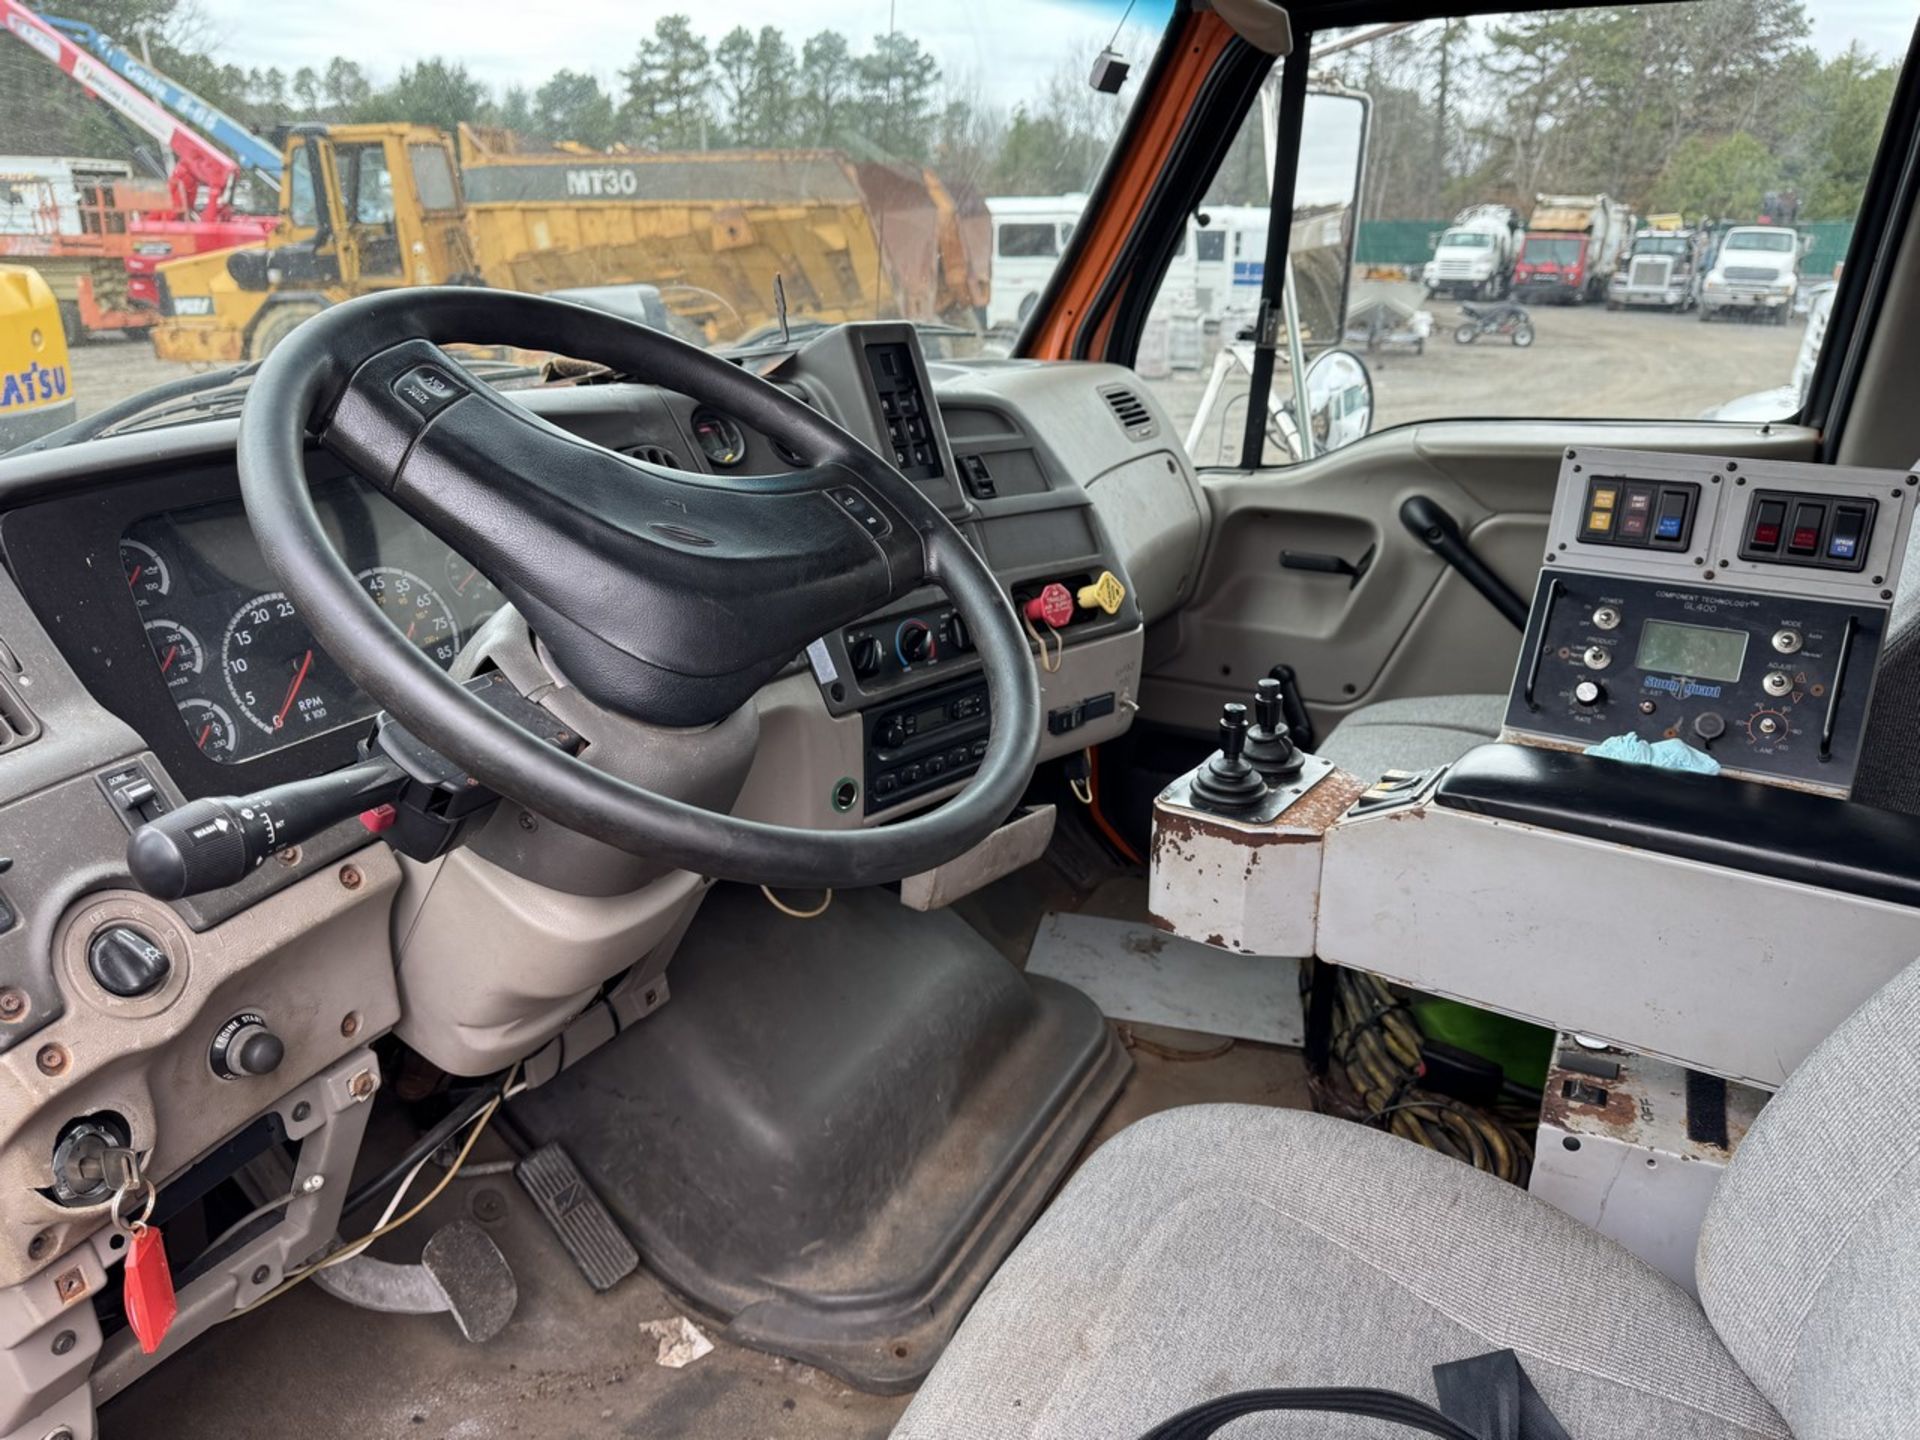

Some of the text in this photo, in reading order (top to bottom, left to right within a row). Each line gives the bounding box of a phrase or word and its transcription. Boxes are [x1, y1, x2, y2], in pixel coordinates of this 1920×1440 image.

[566, 169, 637, 195] MT30
[370, 577, 386, 591] 45
[395, 579, 411, 594] 55
[416, 594, 433, 608] 65
[1655, 590, 1699, 602] COMPONENT
[250, 608, 270, 625] 20
[276, 602, 295, 617] 25
[431, 616, 449, 631] 75
[235, 630, 252, 646] 15
[436, 645, 453, 660] 85
[230, 658, 249, 674] 10
[245, 690, 256, 705] 5
[298, 696, 323, 711] RPM
[312, 708, 327, 719] 100
[193, 823, 217, 839] WASH
[89, 908, 107, 925] OFF
[214, 1020, 241, 1050] ENGINE
